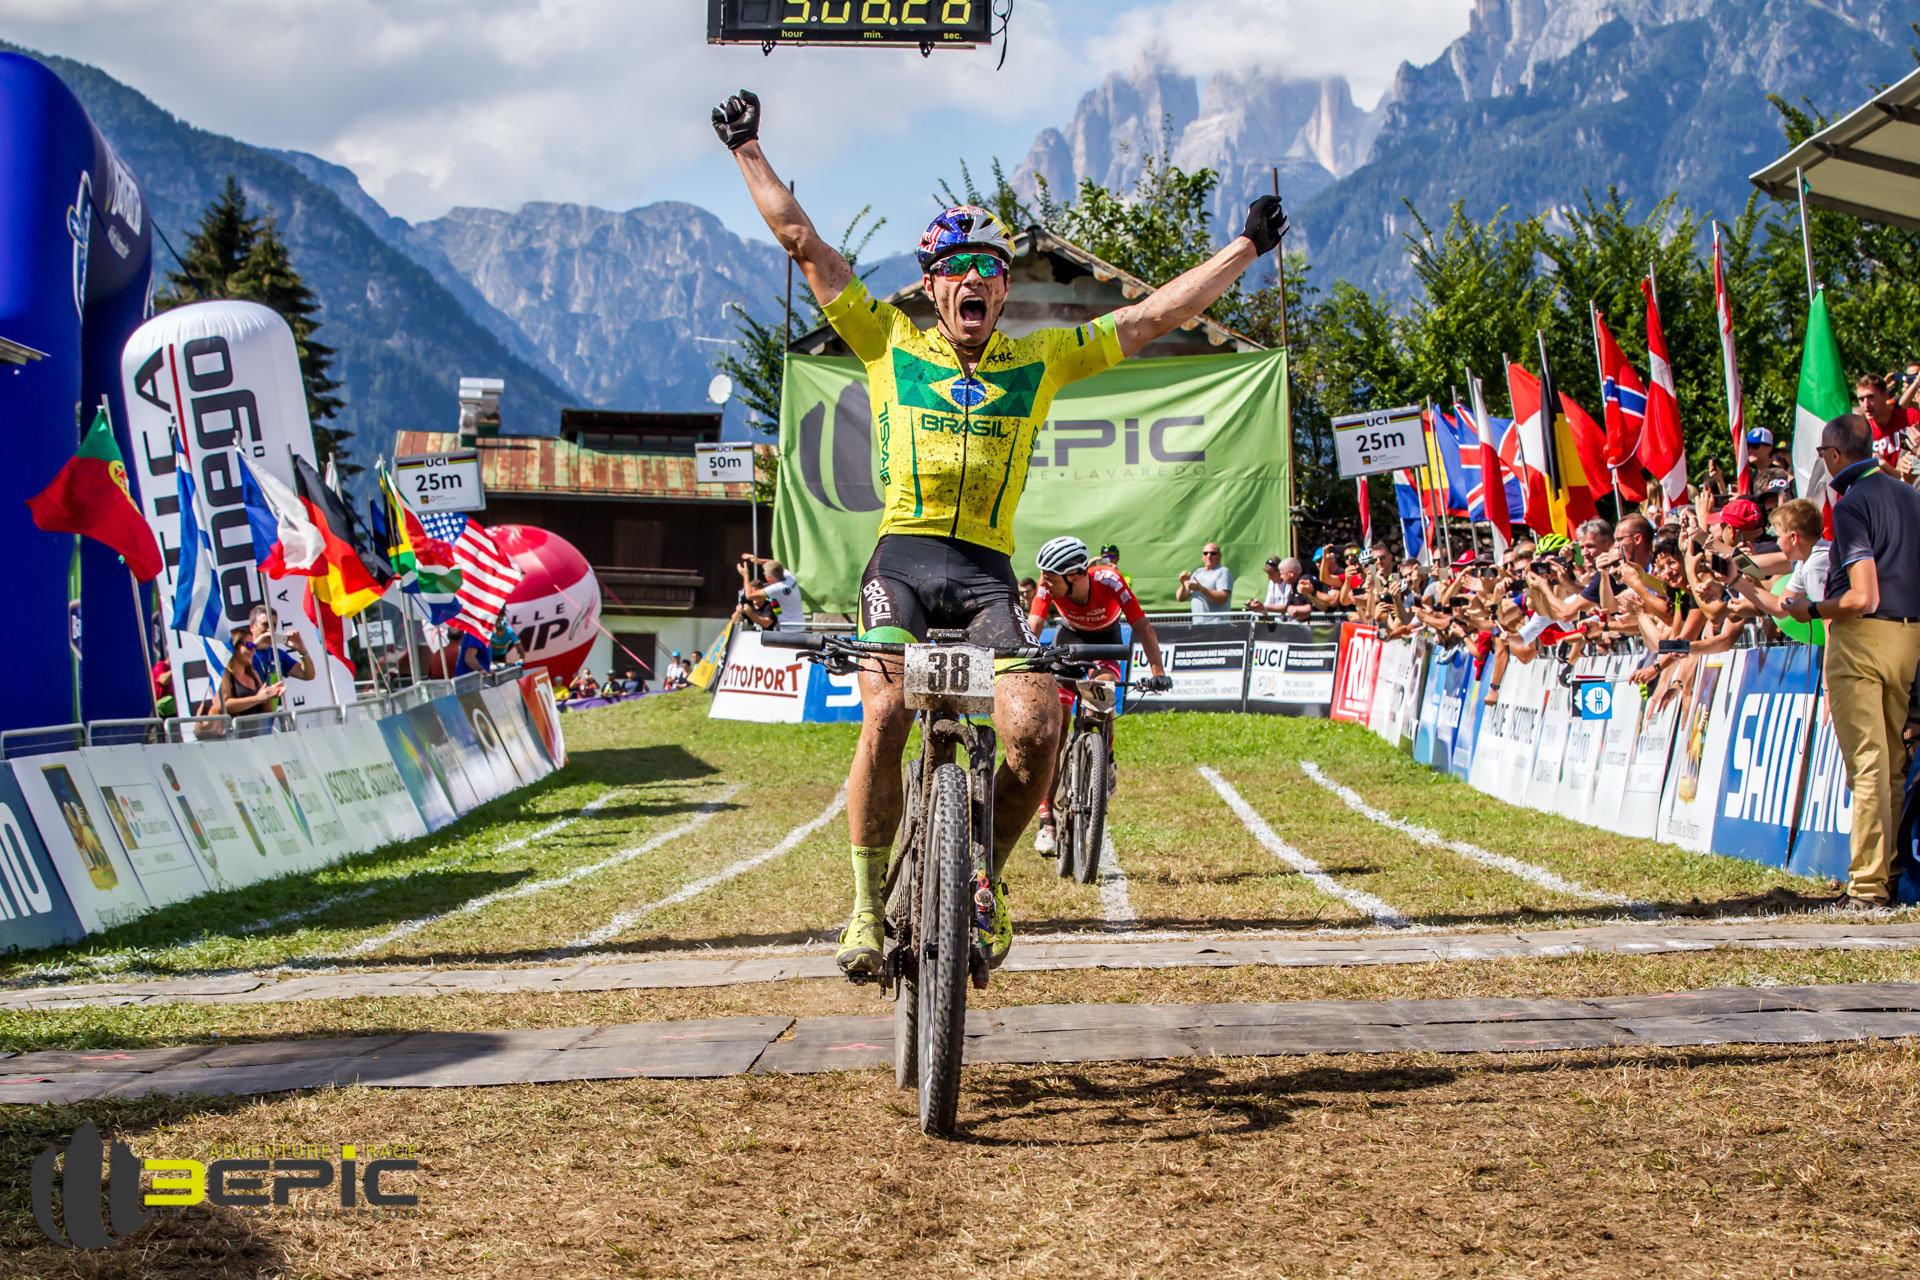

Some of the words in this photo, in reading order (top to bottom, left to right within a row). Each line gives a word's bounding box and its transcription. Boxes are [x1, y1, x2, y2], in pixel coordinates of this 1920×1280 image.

[781, 29, 804, 39] hour
[863, 30, 884, 40] min.
[943, 31, 962, 40] sec.
[921, 413, 1008, 438] BRASIL
[1366, 416, 1388, 427] UCI
[878, 402, 892, 487] BRASIL
[1356, 432, 1405, 453] 25m
[425, 457, 447, 467] UCI
[709, 456, 741, 468] 50m
[1074, 465, 1206, 480] LAVAREDO
[415, 473, 462, 492] 25m
[863, 579, 891, 627] BRASIL
[1259, 649, 1283, 667] UCI
[927, 652, 970, 692] 38
[1089, 686, 1105, 700] 10
